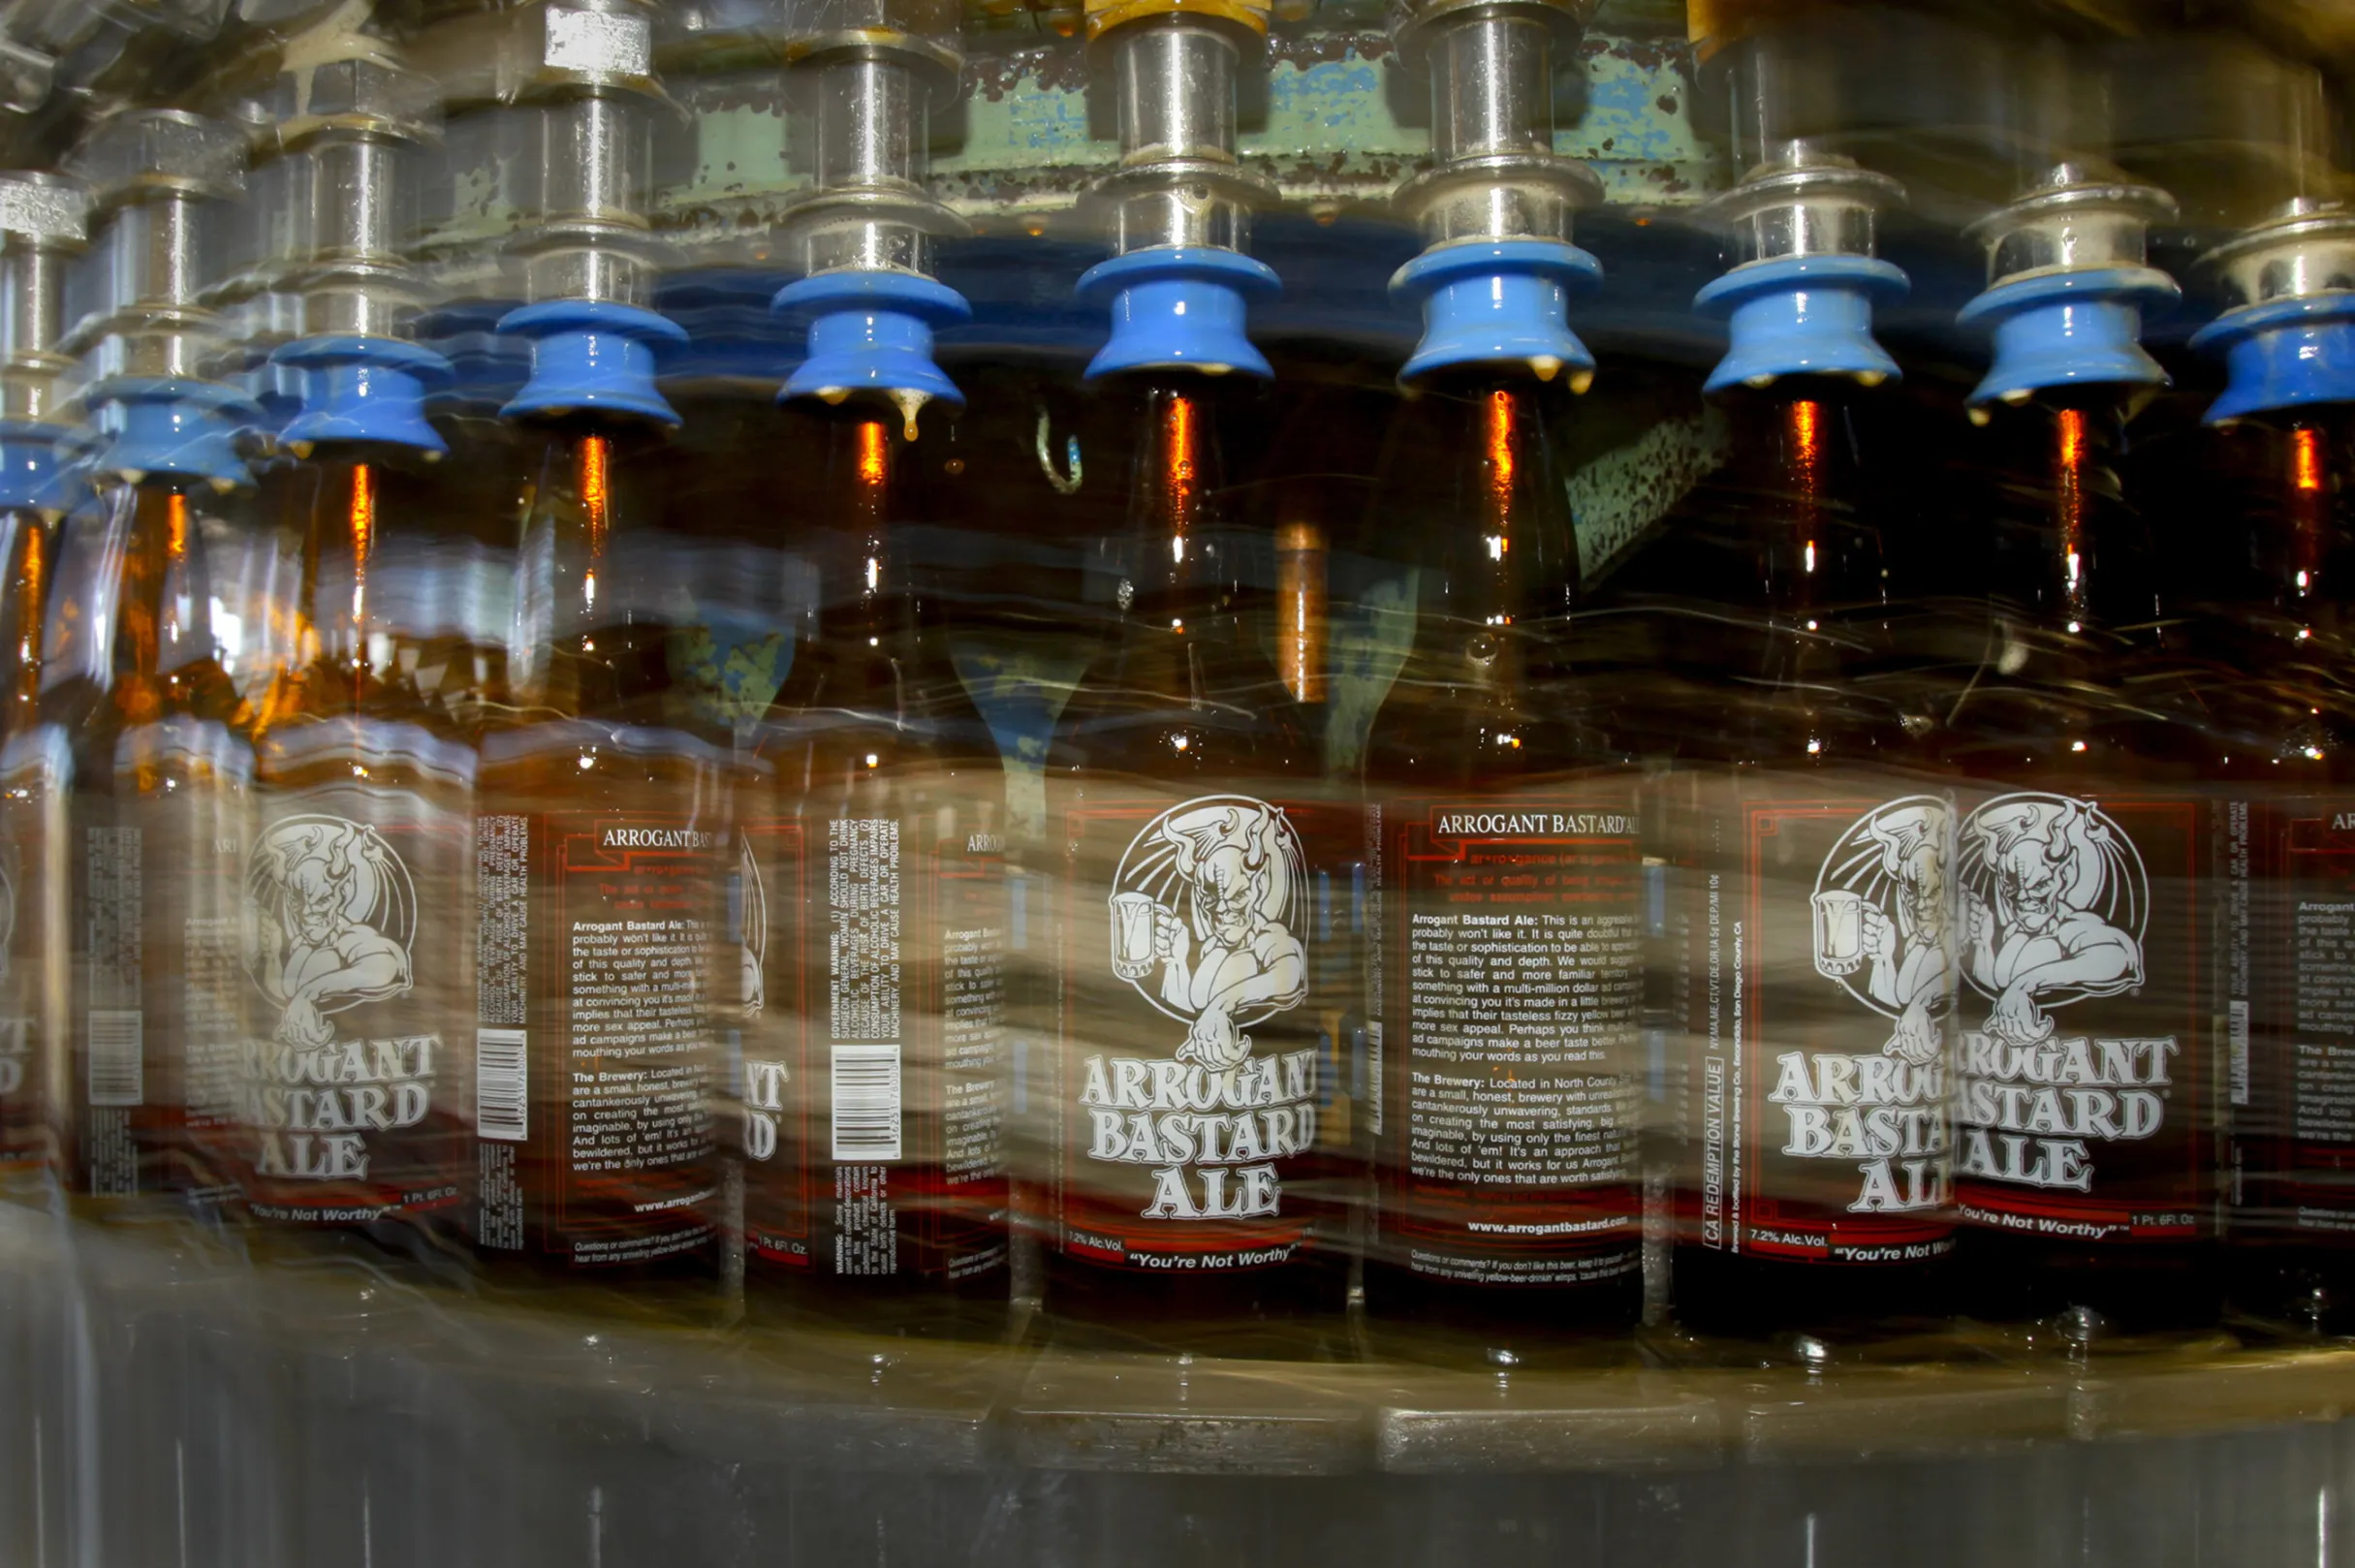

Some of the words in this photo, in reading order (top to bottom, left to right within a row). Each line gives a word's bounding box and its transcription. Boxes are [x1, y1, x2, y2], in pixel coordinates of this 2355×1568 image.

[831, 820, 839, 833] THE
[840, 819, 850, 846] DRINK
[861, 819, 869, 831] (2)
[1438, 814, 1548, 834] ARROGANT
[604, 830, 691, 847] ARROGANT
[831, 837, 839, 852] TO
[851, 819, 860, 873] PREGNANCY
[870, 819, 880, 856] IMPAIRS
[881, 819, 890, 859] OPERATE
[891, 821, 899, 868] PROBLEMS.
[840, 851, 850, 865] NOT
[861, 838, 869, 878] DEFECTS.
[831, 853, 839, 906] ACCORDING
[881, 864, 890, 878] OR
[840, 873, 850, 908] SHOULD
[870, 858, 880, 908] BEVERAGES
[881, 884, 890, 902] CAR
[891, 872, 899, 905] HEALTH
[851, 883, 860, 918] DURING
[861, 882, 869, 910] BIRTH
[573, 922, 623, 933] Arrogant
[627, 921, 666, 930] Bastard
[831, 910, 839, 923] (1)
[861, 916, 869, 927] OF
[891, 909, 899, 937] CAUSE
[1412, 914, 1458, 926] Arrogant
[1462, 915, 1509, 925] Bastard
[1514, 915, 1538, 925] Ale:
[1542, 915, 1565, 925] This
[1569, 915, 1578, 925] is
[1582, 917, 1593, 925] an
[840, 912, 850, 947] WOMEN
[870, 910, 880, 960] ALCOHOLIC
[881, 922, 890, 949] DRIVE
[1412, 927, 1454, 940] probably
[1458, 928, 1488, 938] won't
[1492, 928, 1512, 939] like
[1517, 929, 1526, 939] it.
[1532, 928, 1539, 939] It
[1544, 930, 1554, 939] is
[1557, 929, 1583, 941] quite
[831, 931, 839, 975] WARNING:
[851, 927, 860, 979] BEVERAGES
[861, 932, 869, 954] RISK
[891, 941, 899, 959] MAY
[1412, 940, 1427, 951] the
[1429, 941, 1454, 952] taste
[1457, 943, 1468, 952] or
[1471, 942, 1548, 955] sophistication
[1551, 943, 1561, 953] to
[1564, 942, 1577, 953] be
[861, 959, 869, 976] THE
[870, 962, 880, 973] OF
[881, 955, 890, 966] TO
[1412, 954, 1422, 963] of
[1426, 955, 1443, 964] this
[1448, 956, 1485, 968] quality
[1490, 956, 1512, 966] and
[1518, 956, 1553, 968] depth.
[1557, 956, 1575, 966] We
[891, 963, 899, 982] AND
[1412, 967, 1434, 977] stick
[1440, 968, 1450, 979] to
[1457, 969, 1486, 980] safer
[1492, 969, 1515, 980] and
[1523, 971, 1552, 980] more
[1558, 969, 1595, 980] familiar
[861, 983, 869, 993] OF
[881, 973, 890, 1007] ABILITY
[1412, 982, 1463, 995] something
[1466, 983, 1489, 992] with
[1492, 985, 1500, 993] a
[1504, 983, 1570, 993] multi-million
[1572, 983, 1599, 993] dollar
[831, 980, 839, 1039] GOVERNMENT
[840, 997, 850, 1039] SURGEON
[851, 988, 860, 1039] ALCOHOLIC
[870, 975, 880, 1039] CONSUMPTION
[861, 999, 869, 1039] BECAUSE
[881, 1014, 890, 1038] YOUR
[240, 1033, 444, 1085] RROGANT
[1412, 1048, 1457, 1062] mouthing
[1460, 1051, 1484, 1062] your
[1487, 1051, 1522, 1062] words
[1524, 1053, 1538, 1062] as
[1541, 1053, 1561, 1064] you
[1564, 1051, 1586, 1061] read
[573, 1073, 594, 1082] The
[599, 1072, 647, 1082] Brewery:
[650, 1067, 683, 1079] Located
[1412, 1072, 1430, 1083] The
[1434, 1074, 1485, 1090] Brewery:
[1490, 1078, 1535, 1089] Located
[1540, 1079, 1550, 1088] in
[1554, 1078, 1584, 1088] North
[1412, 1087, 1427, 1097] are
[1429, 1089, 1436, 1098] a
[1438, 1089, 1469, 1102] small,
[1473, 1090, 1515, 1103] honest,
[1519, 1092, 1563, 1105] brewery
[1565, 1091, 1586, 1102] with
[1707, 1064, 1723, 1112] VALUE
[240, 1083, 434, 1132] ASTARD
[1086, 1104, 1317, 1165] BASTARD
[1781, 1104, 1950, 1159] BASTA
[254, 1132, 372, 1181] ALE
[1705, 1114, 1722, 1216] REDEMPTION
[1960, 1128, 2094, 1193] ALE
[1140, 1162, 1282, 1221] ALE
[291, 1207, 319, 1222] Not
[1467, 1215, 1628, 1236] www.arrogantbastard.com
[2132, 1214, 2139, 1226] 1
[2142, 1214, 2156, 1226] Pt.
[1705, 1219, 1718, 1241] CA
[2002, 1213, 2033, 1230] Not
[2038, 1215, 2119, 1239] Worthy"
[791, 1241, 807, 1255] Oz.
[1088, 1236, 1124, 1252] Alc.Vol.
[1750, 1229, 1780, 1243] 7.2%
[1782, 1233, 1829, 1247] Alc.Vol.
[1129, 1252, 1196, 1270] "You're
[1201, 1252, 1233, 1270] Not
[1834, 1245, 1900, 1262] "You're
[1904, 1243, 1930, 1259] Not
